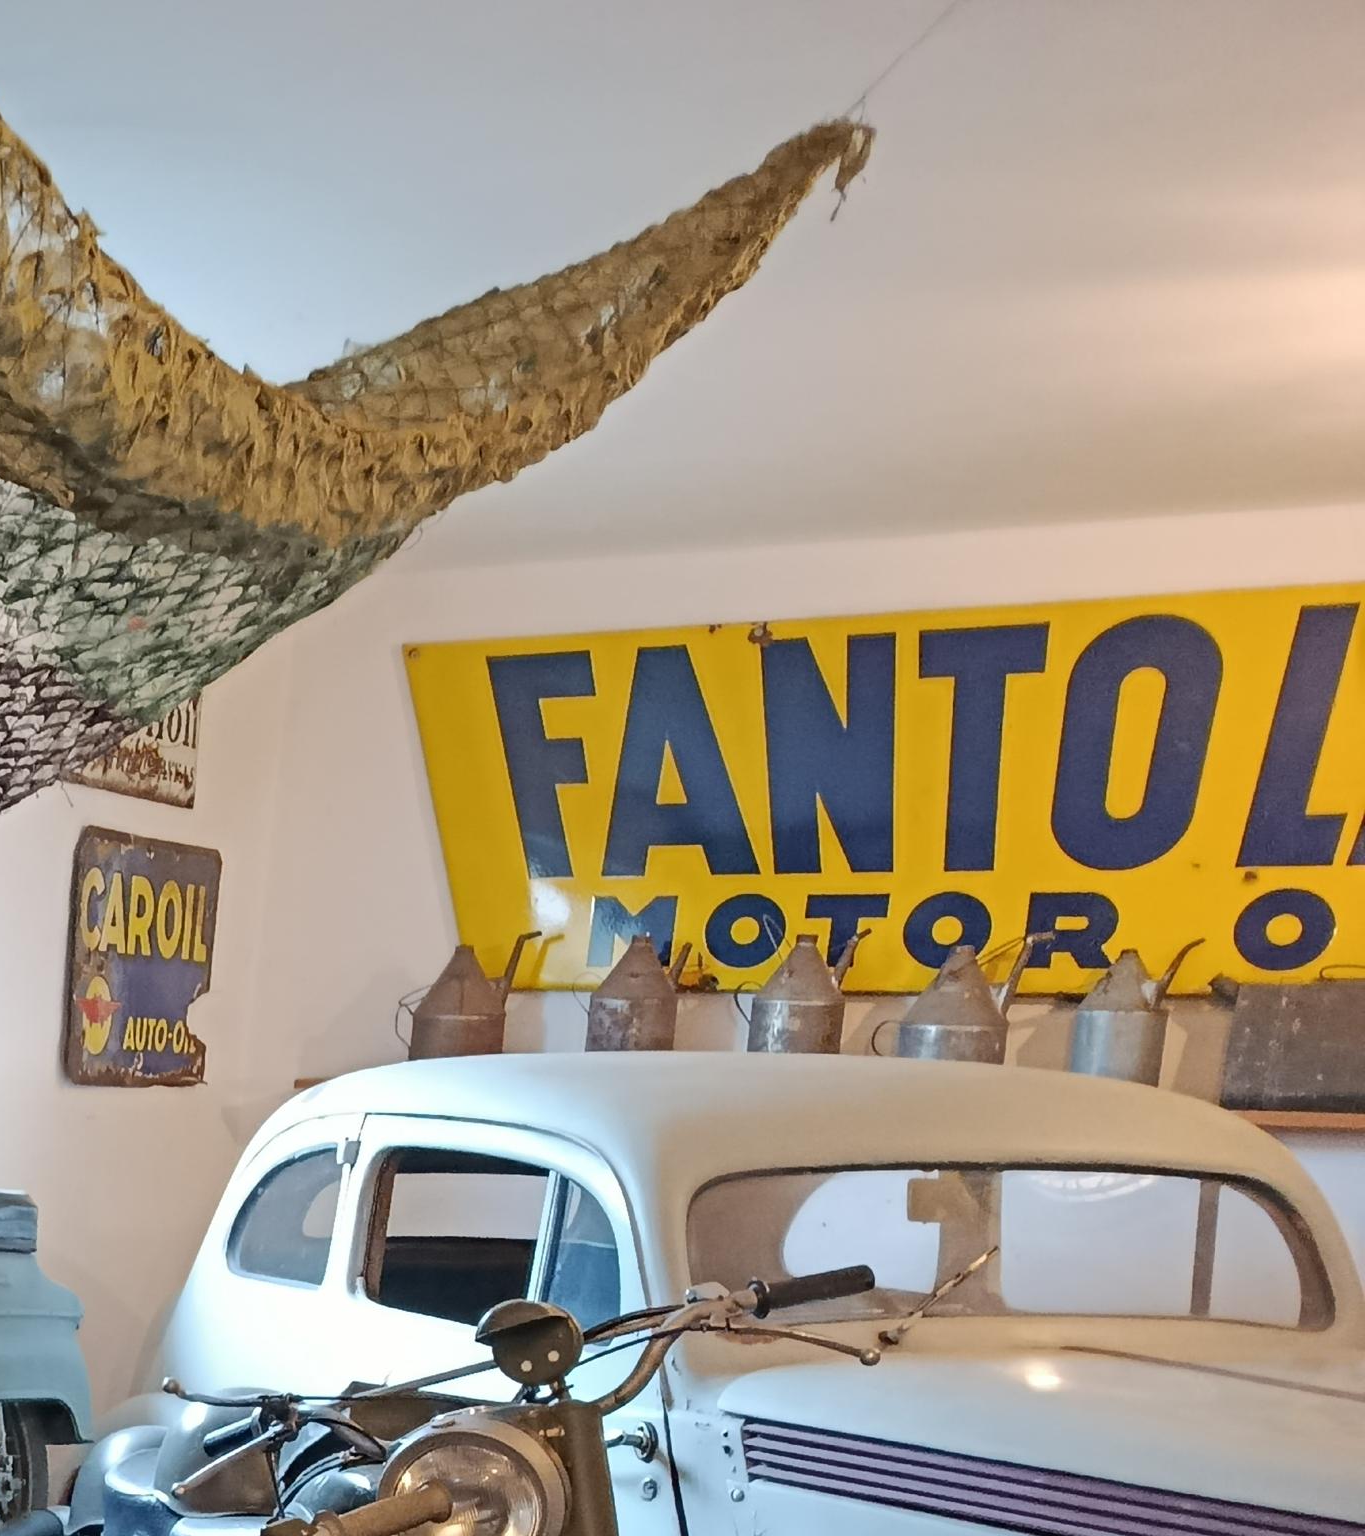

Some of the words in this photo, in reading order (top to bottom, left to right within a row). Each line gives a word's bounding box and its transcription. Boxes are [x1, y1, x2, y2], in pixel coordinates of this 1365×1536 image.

[487, 603, 1365, 877] FANTOL
[80, 867, 207, 962] CAROIL
[587, 890, 1120, 970] MOTOR
